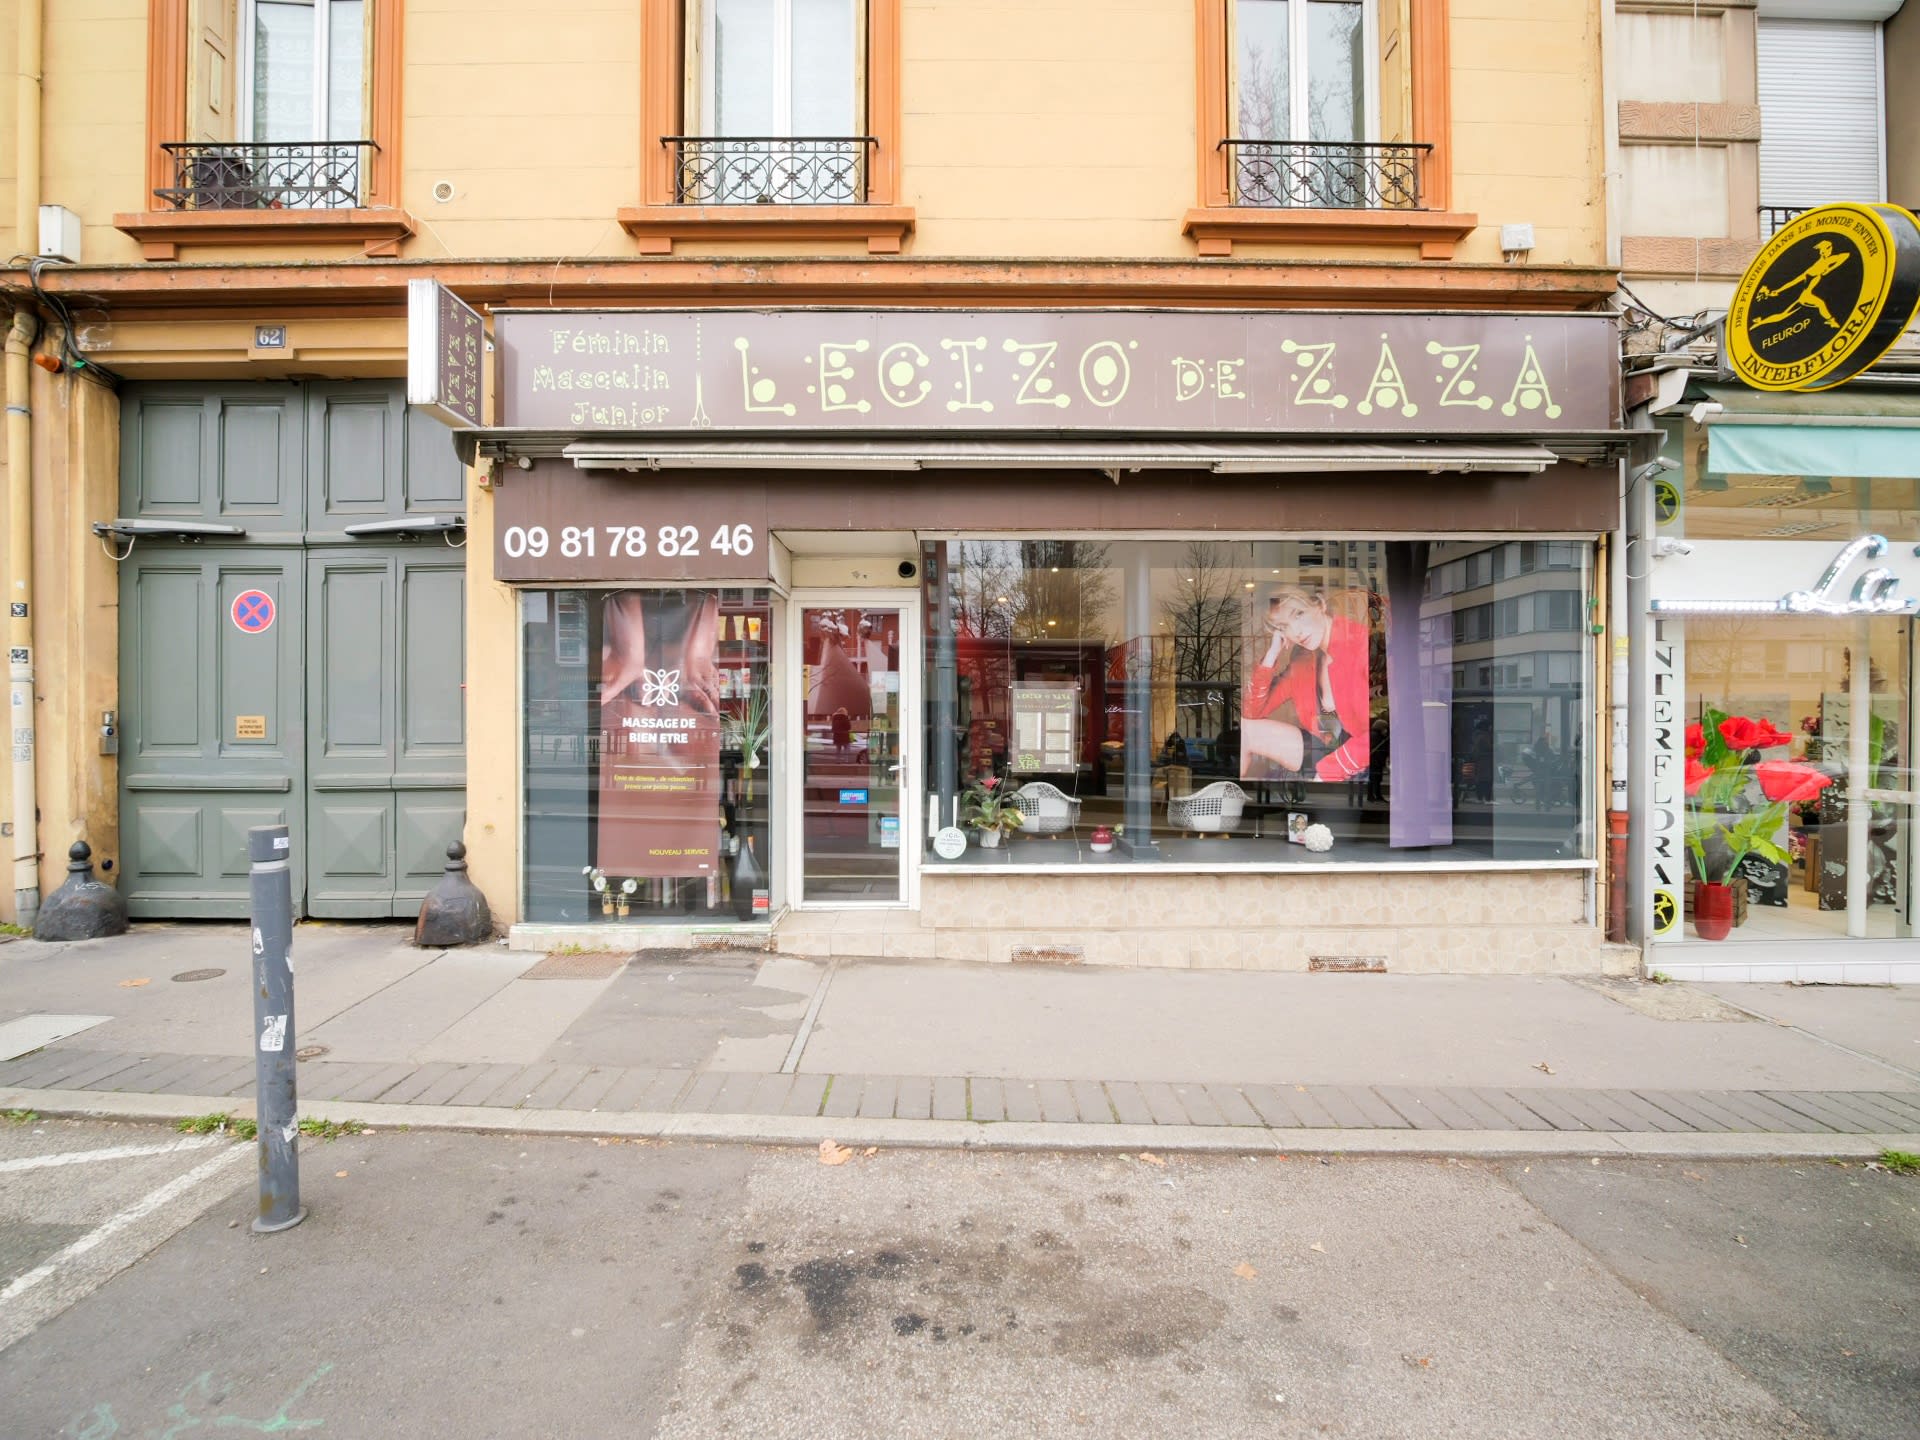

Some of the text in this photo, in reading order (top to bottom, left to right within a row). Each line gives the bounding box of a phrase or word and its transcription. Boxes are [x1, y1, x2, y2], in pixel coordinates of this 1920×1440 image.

[1742, 259, 1767, 303] FLEURS
[1768, 231, 1795, 258] DANS
[1798, 222, 1813, 234] LE
[1816, 216, 1854, 227] MONDE
[1853, 222, 1879, 257] ENTIER
[260, 329, 280, 345] 62
[549, 329, 670, 355] Féminin
[1742, 297, 1875, 381] INTERFLORA
[1762, 318, 1811, 349] FLEUROP
[447, 333, 461, 406] ZAZA
[532, 363, 670, 393] Masculin
[1172, 356, 1246, 401] DE
[1281, 333, 1562, 419] ZAZA
[570, 401, 670, 427] Junior
[504, 524, 754, 557] 09 81 78 82 46
[622, 717, 697, 729] MASSAGE DE
[629, 732, 689, 744] BIEN ETRE
[649, 848, 682, 856] NOUVEAU
